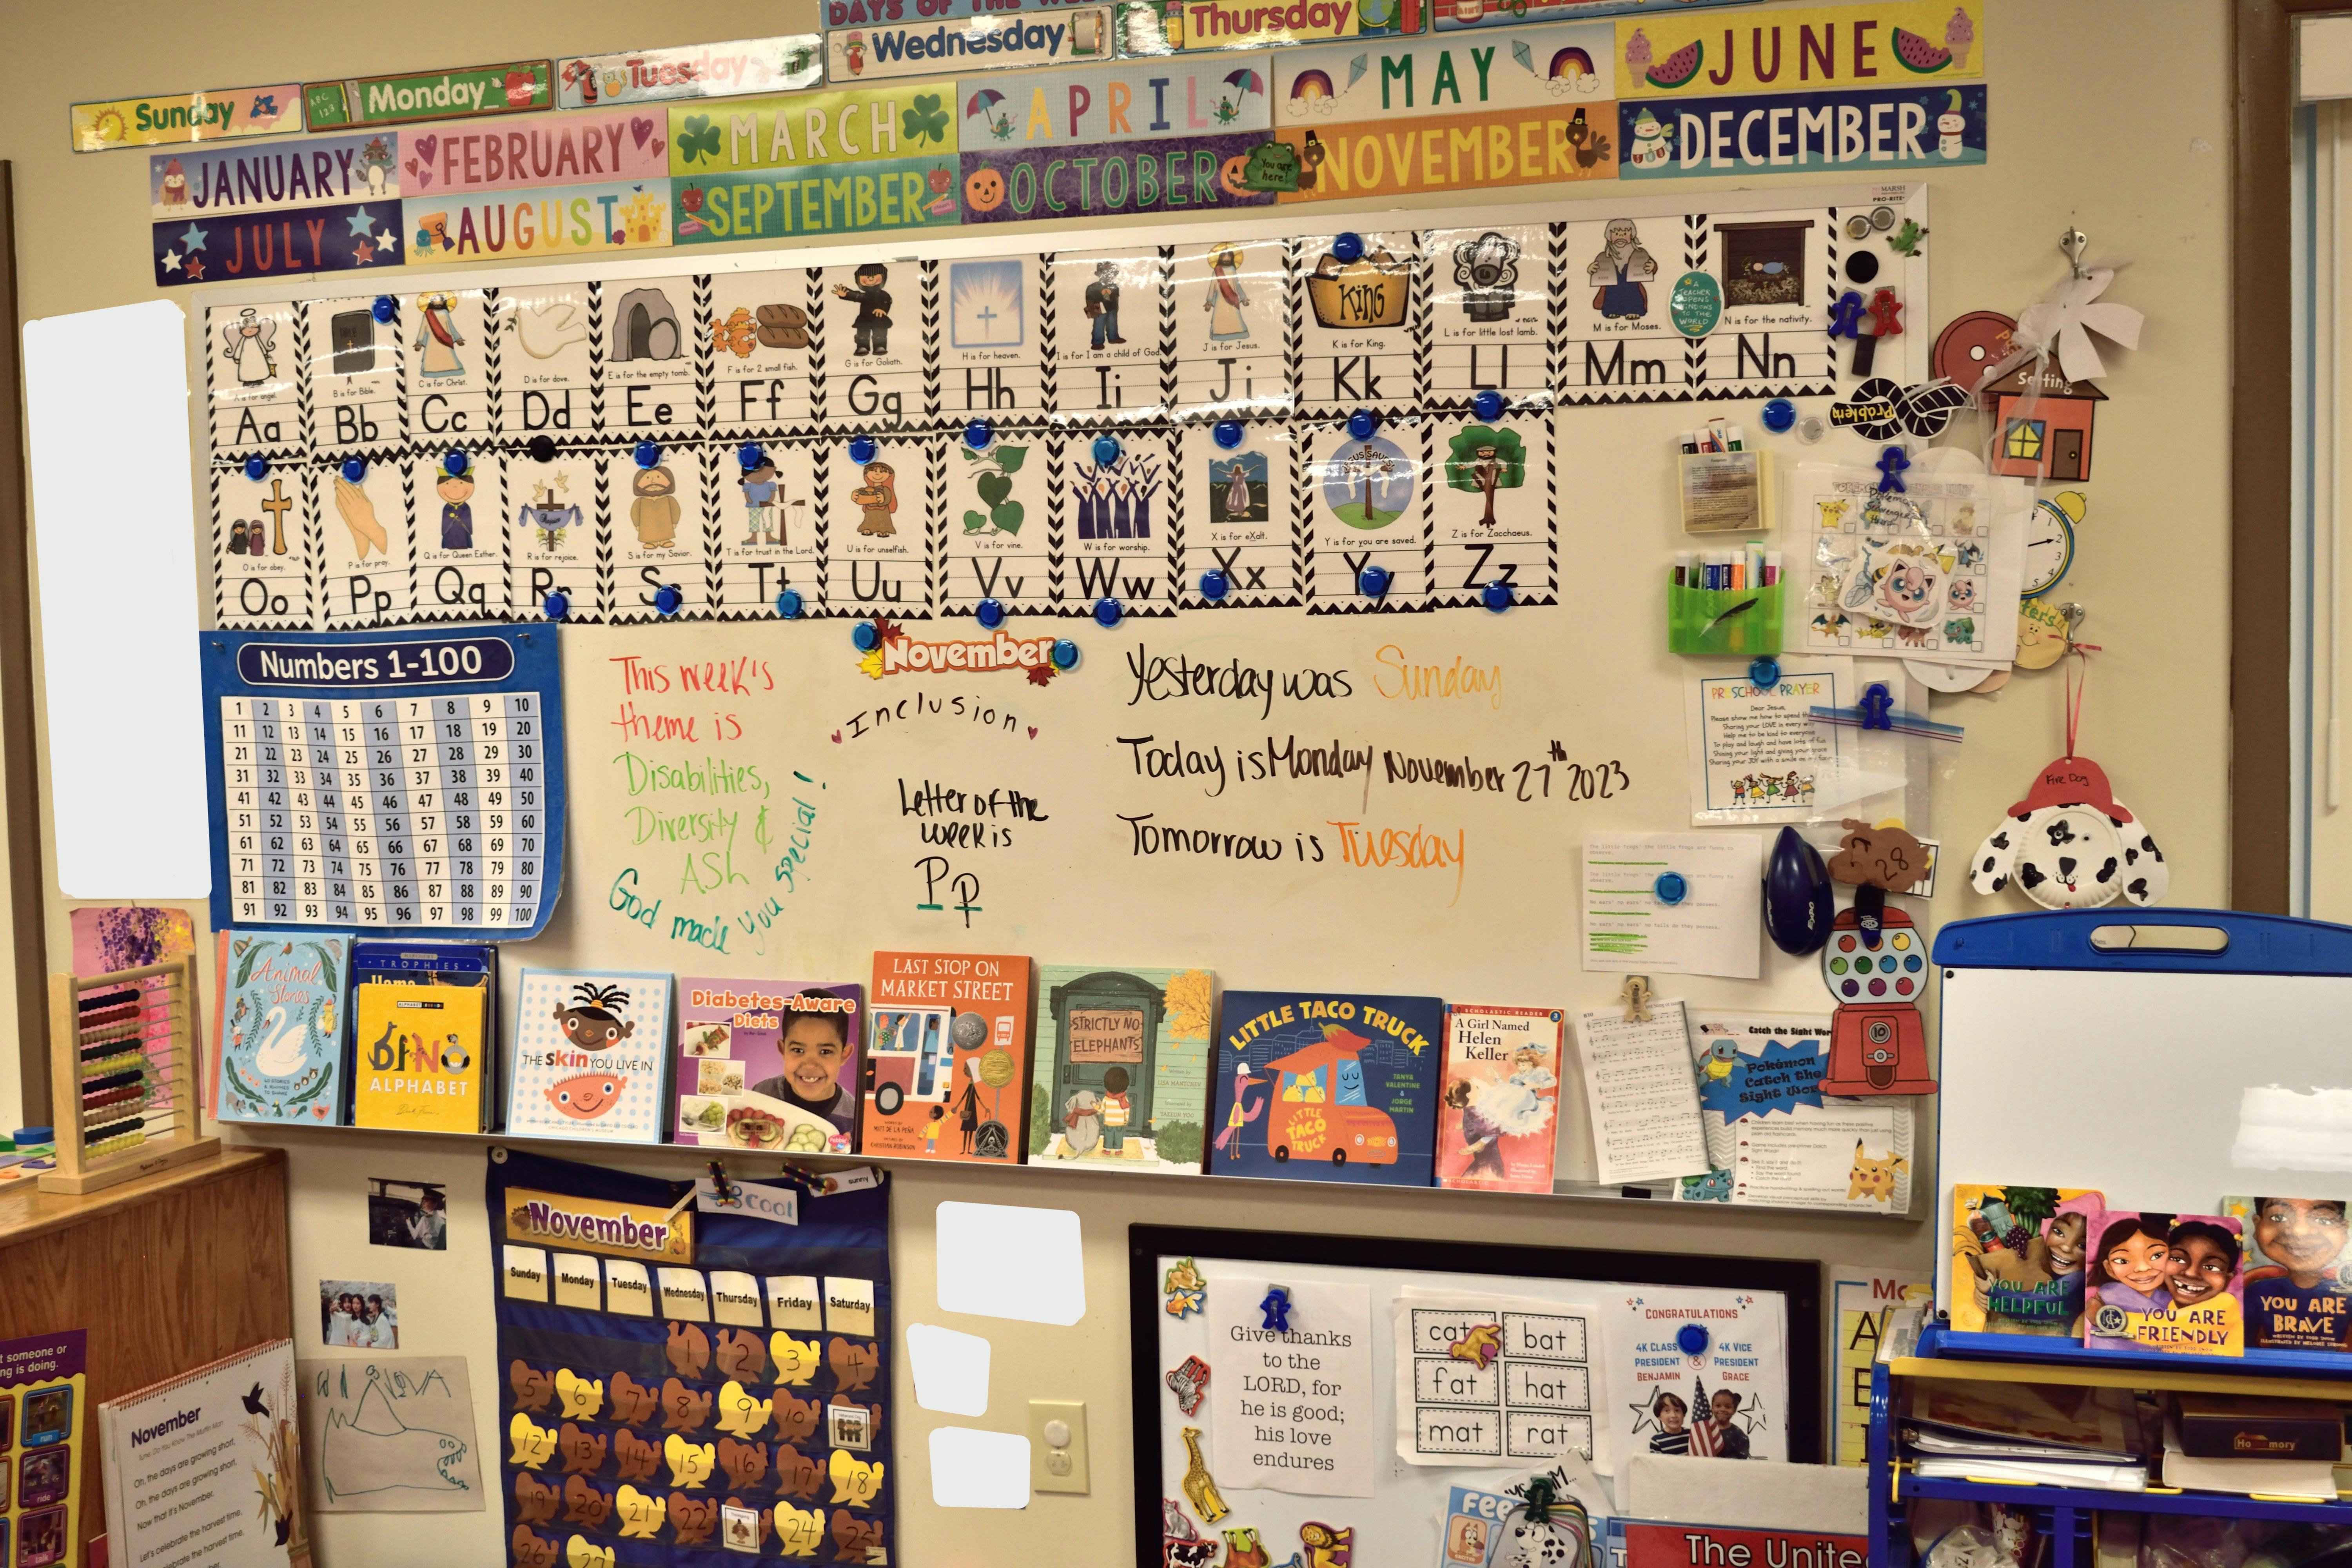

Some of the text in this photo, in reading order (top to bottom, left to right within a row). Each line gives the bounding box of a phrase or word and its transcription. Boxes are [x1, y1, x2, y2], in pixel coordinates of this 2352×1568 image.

[1189, 0, 1351, 38] Thursday
[871, 19, 1065, 62] Wednesday
[1709, 20, 1877, 86] JUNE
[626, 50, 749, 89] Tuesday
[1381, 47, 1496, 109] MAY
[368, 76, 486, 114] Monday
[1026, 76, 1208, 140] APRIL
[136, 99, 235, 133] Sunday
[730, 101, 897, 165] MARCH
[1680, 102, 1926, 169] DECEMBER
[442, 123, 626, 186] FEBRUARY
[1262, 158, 1292, 172] You are
[1317, 120, 1574, 193] NOVEMBER
[193, 148, 355, 209] JANUARY
[1010, 151, 1217, 213] OCTOBER
[1262, 169, 1288, 181] here!
[708, 171, 925, 237] SEPTEMBER
[457, 196, 618, 256] AUGUST
[226, 219, 327, 274] JULY
[978, 352, 991, 360] for
[433, 379, 444, 387] for
[446, 378, 468, 387] Christ.
[1832, 405, 1893, 422] Problem
[1452, 529, 1458, 538] Z
[1470, 529, 1484, 537] for
[1487, 528, 1533, 537] Zacchaeus.
[261, 646, 482, 680] Numbers 1-100
[885, 632, 1054, 671] November
[610, 656, 774, 696] This week's
[1127, 643, 1502, 720] Yesterday was Sunday
[611, 701, 742, 742] theme is
[846, 693, 1016, 739] Inclusion
[613, 751, 770, 799] Disabilities,
[1116, 734, 1225, 797] Today
[1237, 745, 1265, 782] is
[1269, 735, 1373, 814] Monday
[1383, 750, 1504, 792] November
[1568, 760, 1630, 801] 2023
[2046, 773, 2089, 786] Fire Dog
[898, 778, 1049, 821] Letter of the
[624, 806, 738, 851] Diversity
[921, 822, 1011, 848] week is
[1116, 813, 1465, 908] Tomorrow is Tuesday
[609, 868, 662, 929] God
[738, 897, 784, 956] you
[250, 957, 322, 982] Animal
[893, 958, 999, 976] LAST STOP ON
[267, 982, 310, 1004] Stories
[691, 989, 856, 1014] Diabetes-Aware
[881, 979, 1013, 1002] MARKET STREET
[733, 1013, 779, 1029] Diets
[1072, 1017, 1139, 1031] STRICTLY NO
[1228, 1000, 1430, 1056] LITTLE TACO TRUCK
[1455, 1018, 1530, 1031] A Girl Named
[1073, 1037, 1140, 1053] ELEPHANTS
[1458, 1030, 1502, 1045] Helen
[523, 1051, 653, 1071] THE skin YOU LIVE IN
[1466, 1046, 1508, 1061] Keller
[369, 1077, 468, 1096] ALPHABET
[528, 1200, 667, 1251] November
[510, 1267, 871, 1313] Sunday Monday Tuesday Wednesday Thursday Friday Saturday
[2141, 1307, 2226, 1325] YOU ARE
[2261, 1296, 2346, 1314] YOU ARE
[1231, 1325, 1352, 1347] Give thanks
[1524, 1322, 1566, 1352] bat
[2138, 1325, 2229, 1345] FRIENDLY
[2273, 1314, 2334, 1334] BRAVE
[1263, 1352, 1320, 1370] to the
[1636, 1343, 1647, 1352] 4K
[1693, 1356, 1701, 1366] &
[1719, 1343, 1730, 1352] 4K
[1243, 1376, 1341, 1397] LORD, for
[1433, 1367, 1477, 1395] fat
[1526, 1371, 1567, 1400] hat
[1241, 1401, 1344, 1424] he is good;
[132, 1407, 201, 1448] November
[1254, 1426, 1332, 1446] his love
[1430, 1420, 1483, 1443] mat
[1527, 1423, 1567, 1445] rat
[134, 1438, 236, 1488] Oh, the days are growing short,
[1254, 1453, 1334, 1470] endures
